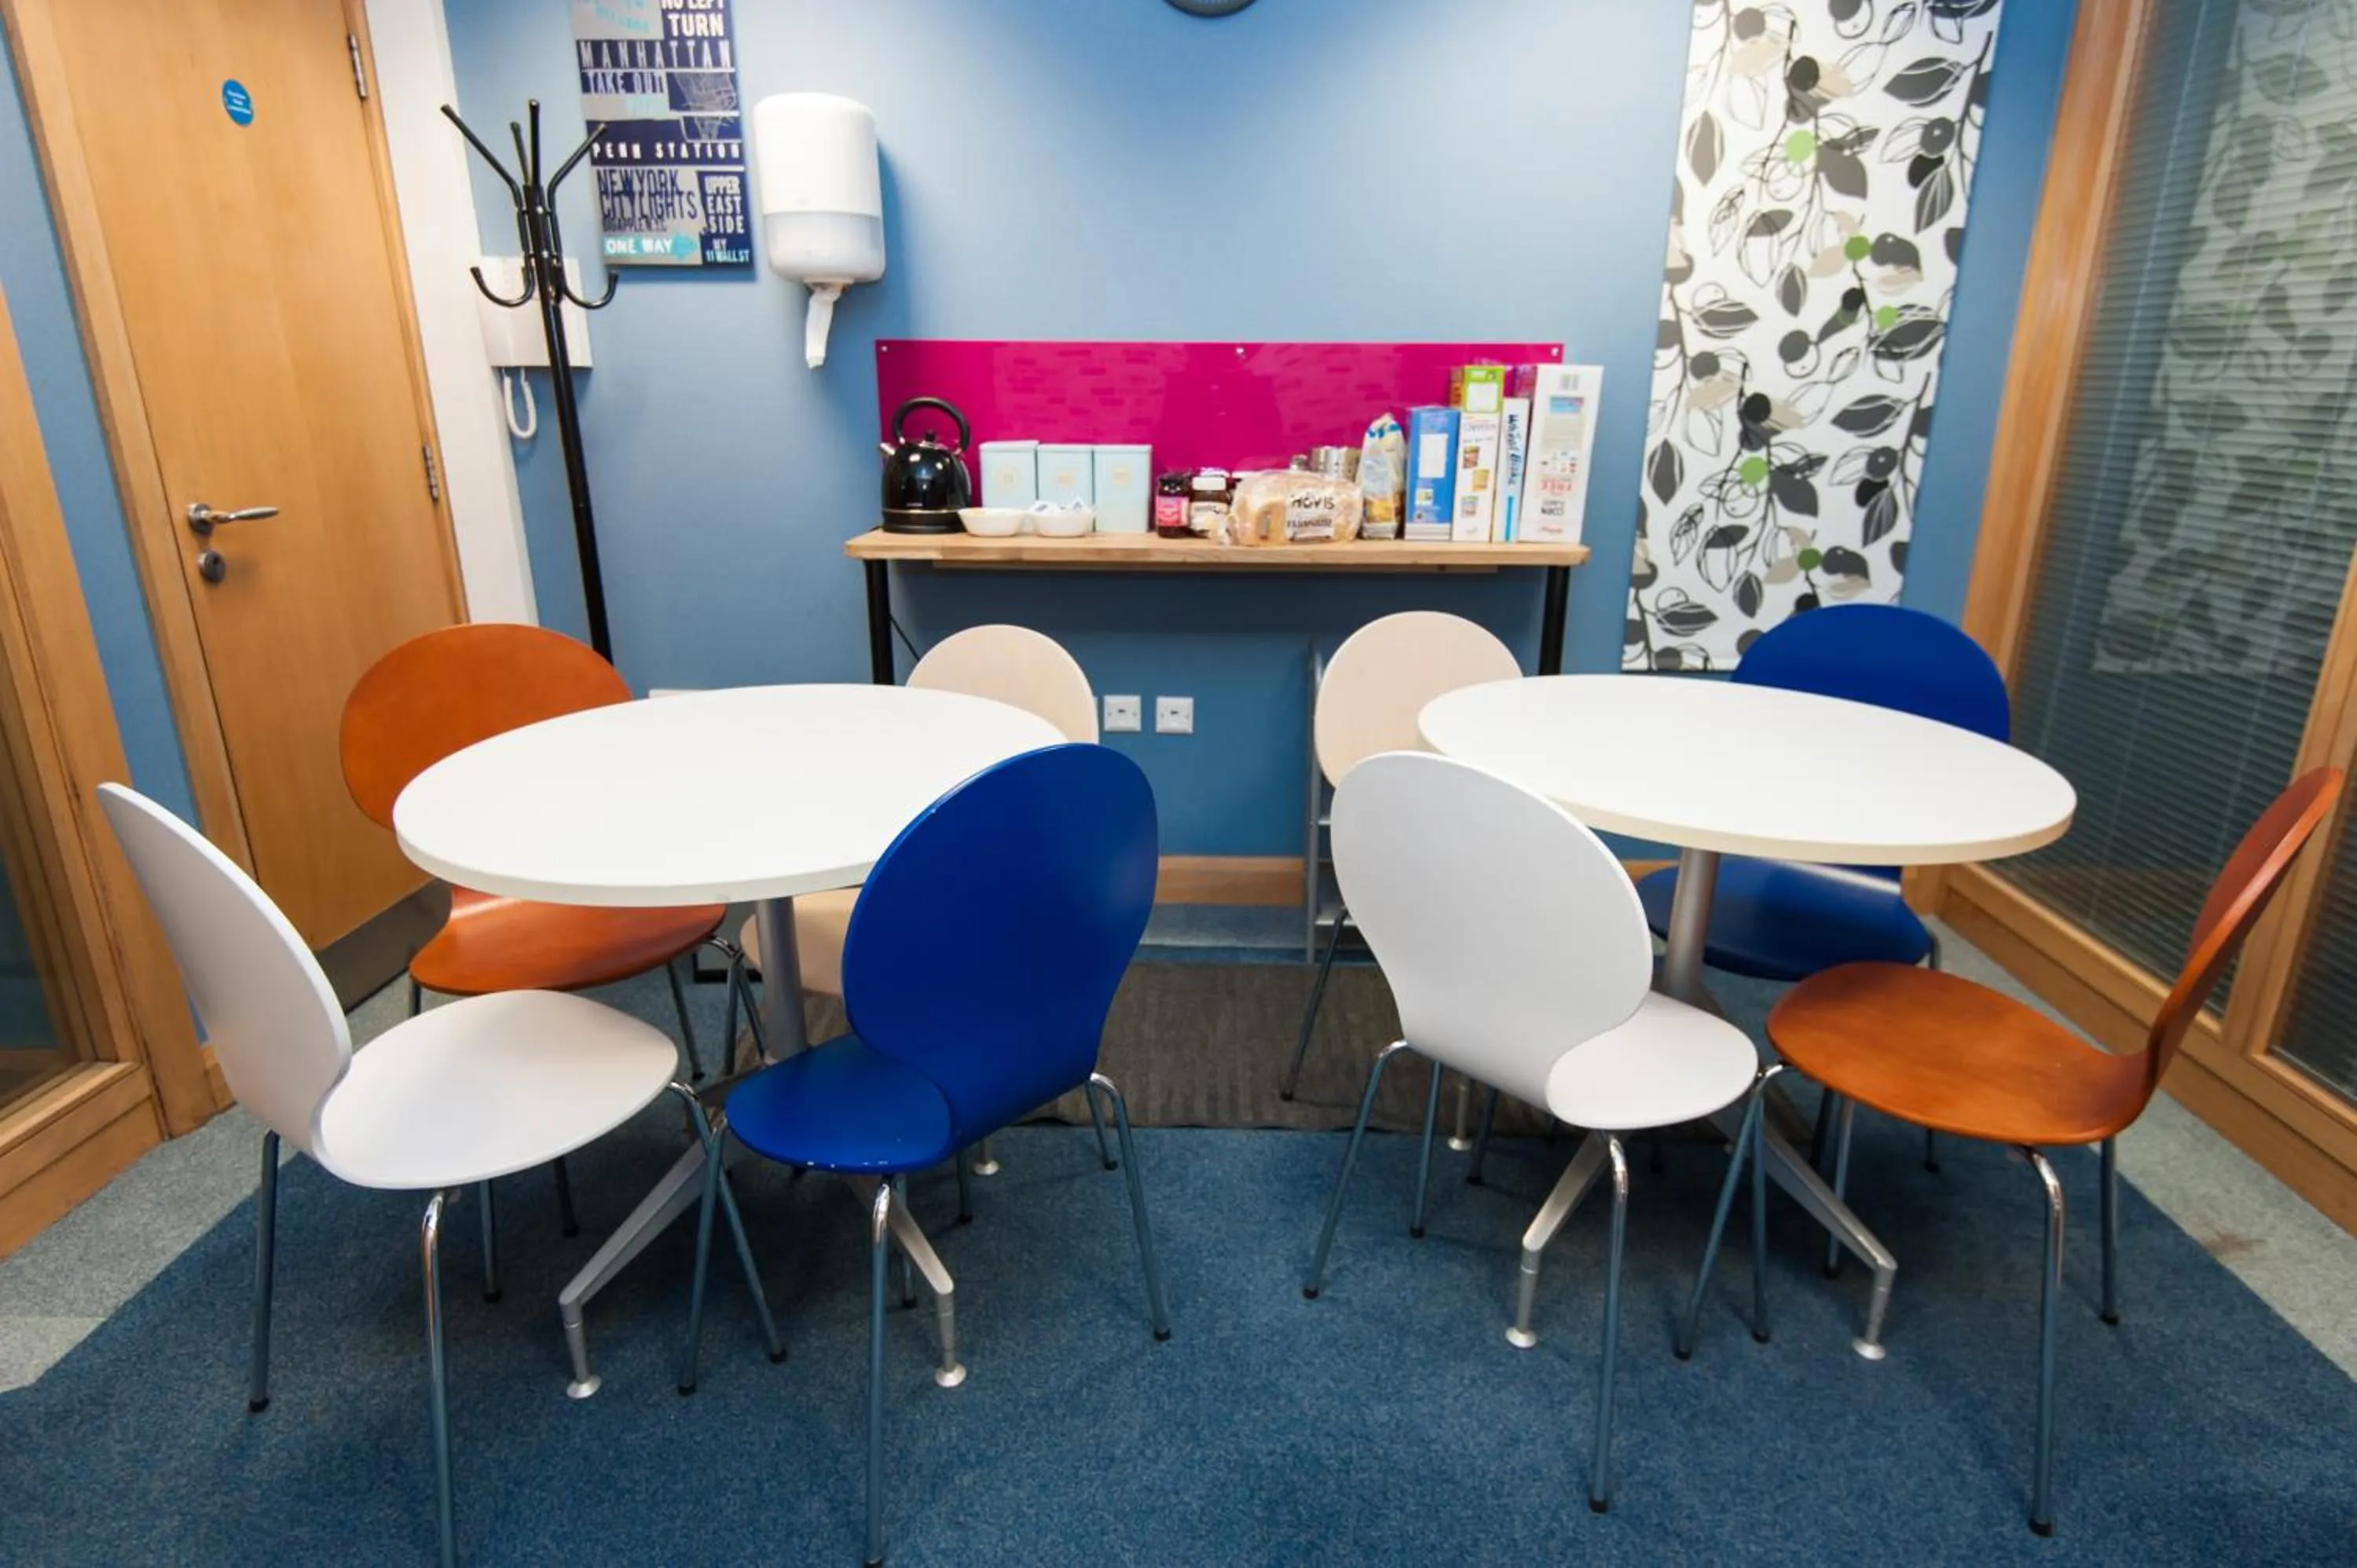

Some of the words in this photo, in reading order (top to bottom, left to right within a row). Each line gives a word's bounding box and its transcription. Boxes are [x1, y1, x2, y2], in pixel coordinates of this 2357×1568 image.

[666, 12, 724, 37] TURN
[580, 40, 731, 68] MANHATTAN
[587, 71, 625, 93] TAKE
[592, 141, 641, 159] PENN
[655, 141, 740, 159] STATION
[704, 175, 740, 195] UPPER
[706, 196, 742, 214] EAST
[709, 214, 745, 233] SIDE
[605, 237, 639, 255] ONE
[642, 237, 673, 254] WAY
